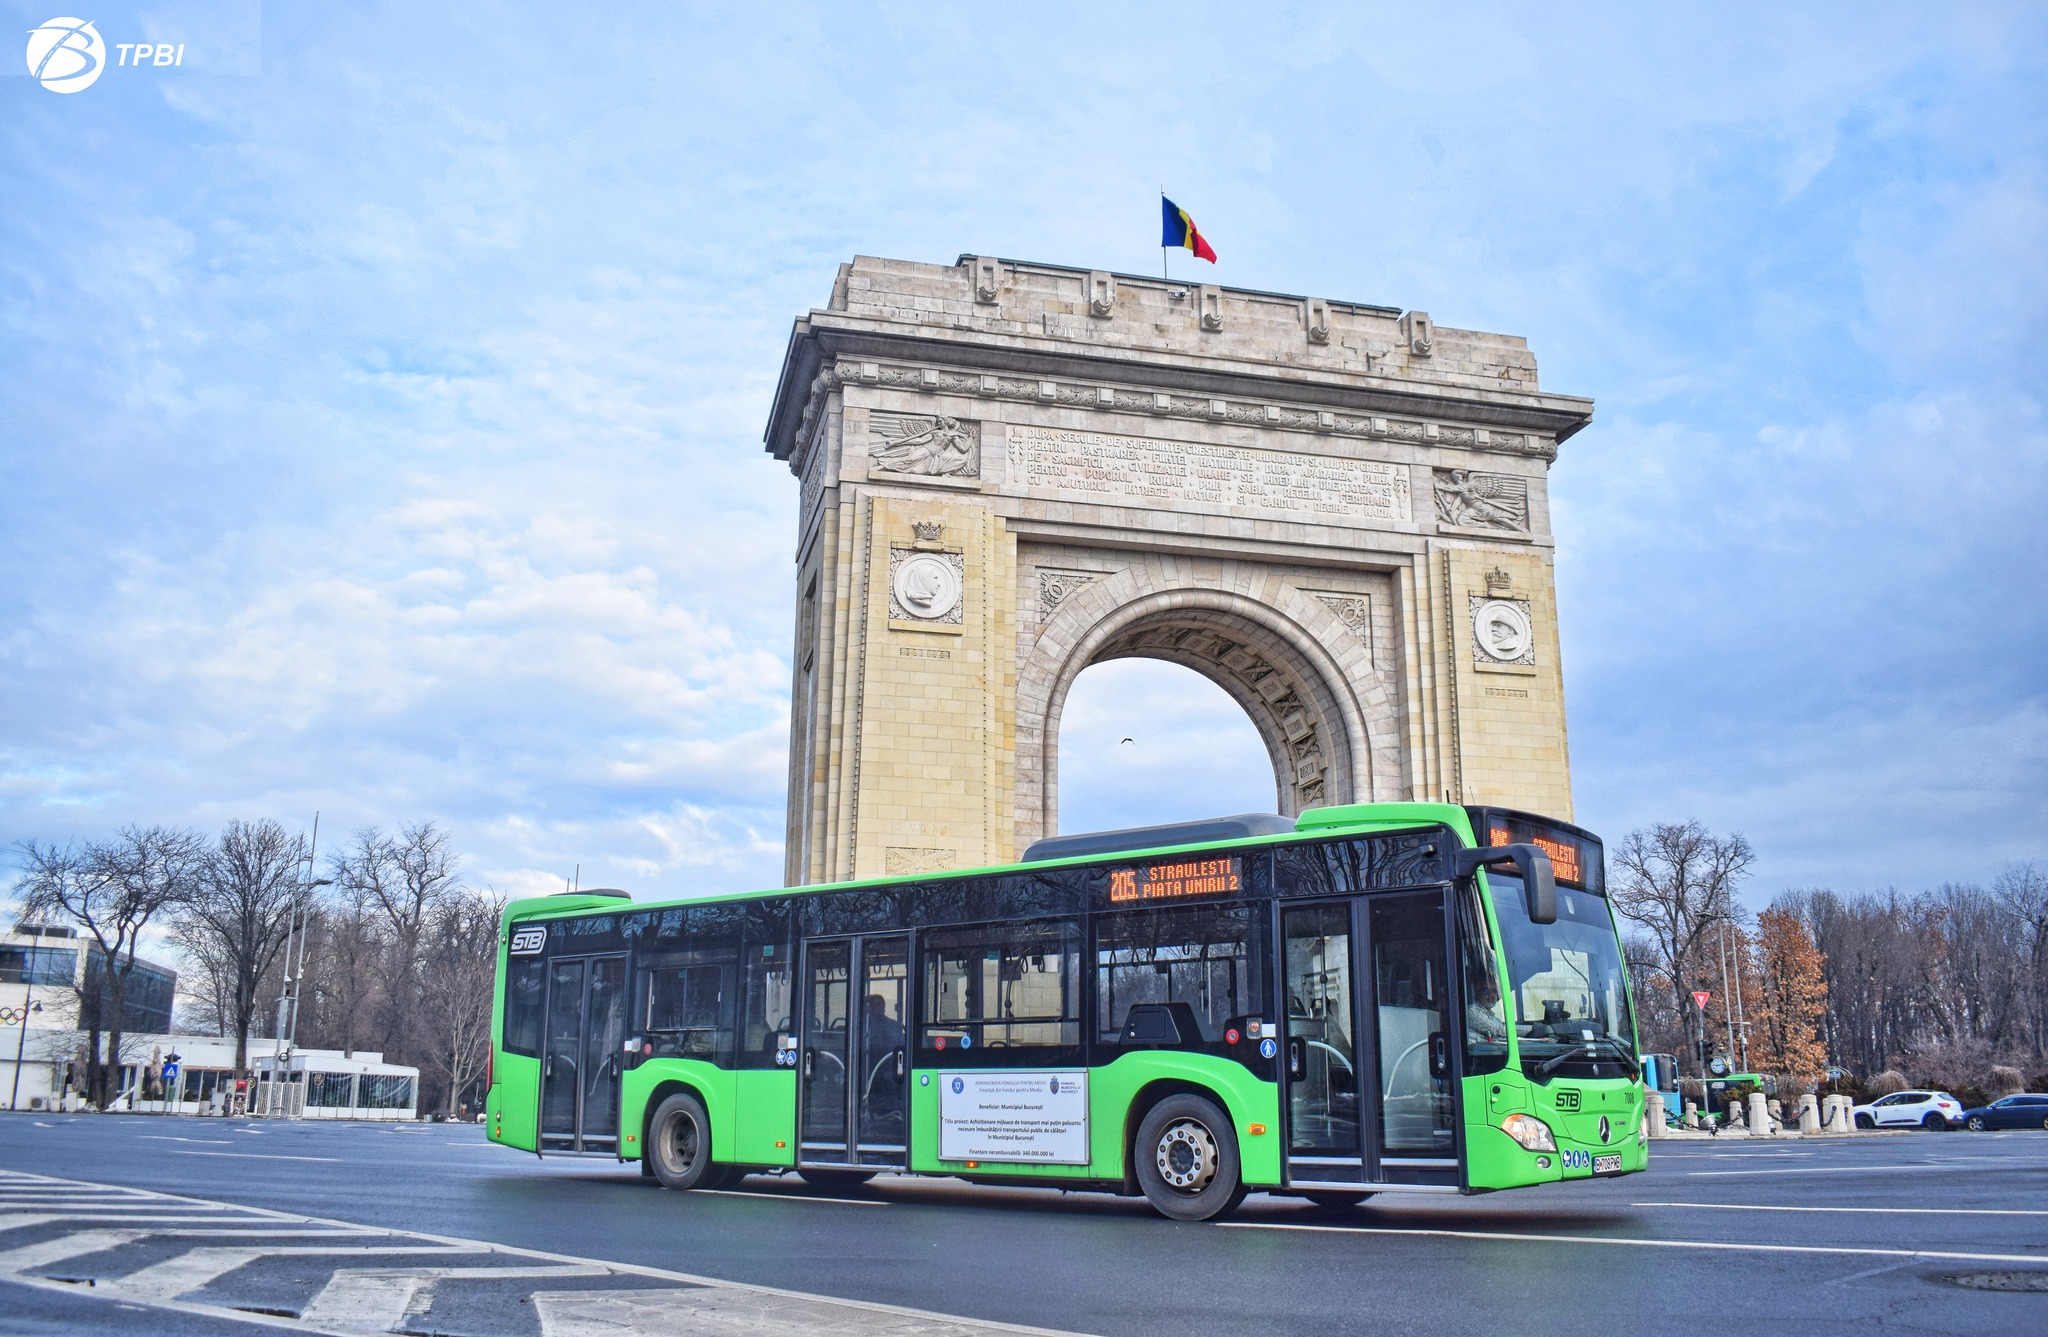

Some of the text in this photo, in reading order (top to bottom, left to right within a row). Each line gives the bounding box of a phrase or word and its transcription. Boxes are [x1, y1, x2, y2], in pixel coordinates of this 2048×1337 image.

[1028, 440, 1067, 453] PENTRU
[1061, 432, 1100, 445] SECOLE
[1107, 437, 1120, 447] DE
[1324, 459, 1354, 471] LUPTE
[1360, 462, 1390, 475] GRELE
[1028, 451, 1041, 462] DE
[1052, 455, 1104, 469] SACRIFICII
[1112, 461, 1120, 471] A
[1197, 468, 1231, 481] UMANE
[1241, 474, 1253, 483] SE
[1319, 480, 1373, 495] DREPTATEA
[1028, 463, 1067, 476] PENTRU
[1086, 468, 1133, 483] POPORUL
[1199, 480, 1222, 491] PRIN
[1238, 484, 1268, 496] SABIA
[1283, 487, 1323, 501] REGELUI
[1339, 493, 1391, 508] FERDINAND
[1028, 475, 1041, 486] CU
[1057, 479, 1111, 493] AJUTORUL
[1313, 502, 1350, 515] REGINEI
[1364, 506, 1394, 519] MARIA
[1150, 859, 1231, 881] STRAULESTI
[1573, 865, 1579, 882] 2
[1143, 875, 1238, 898] PIATA UNIRII 2
[511, 931, 544, 950] STB
[1556, 1092, 1580, 1108] STB
